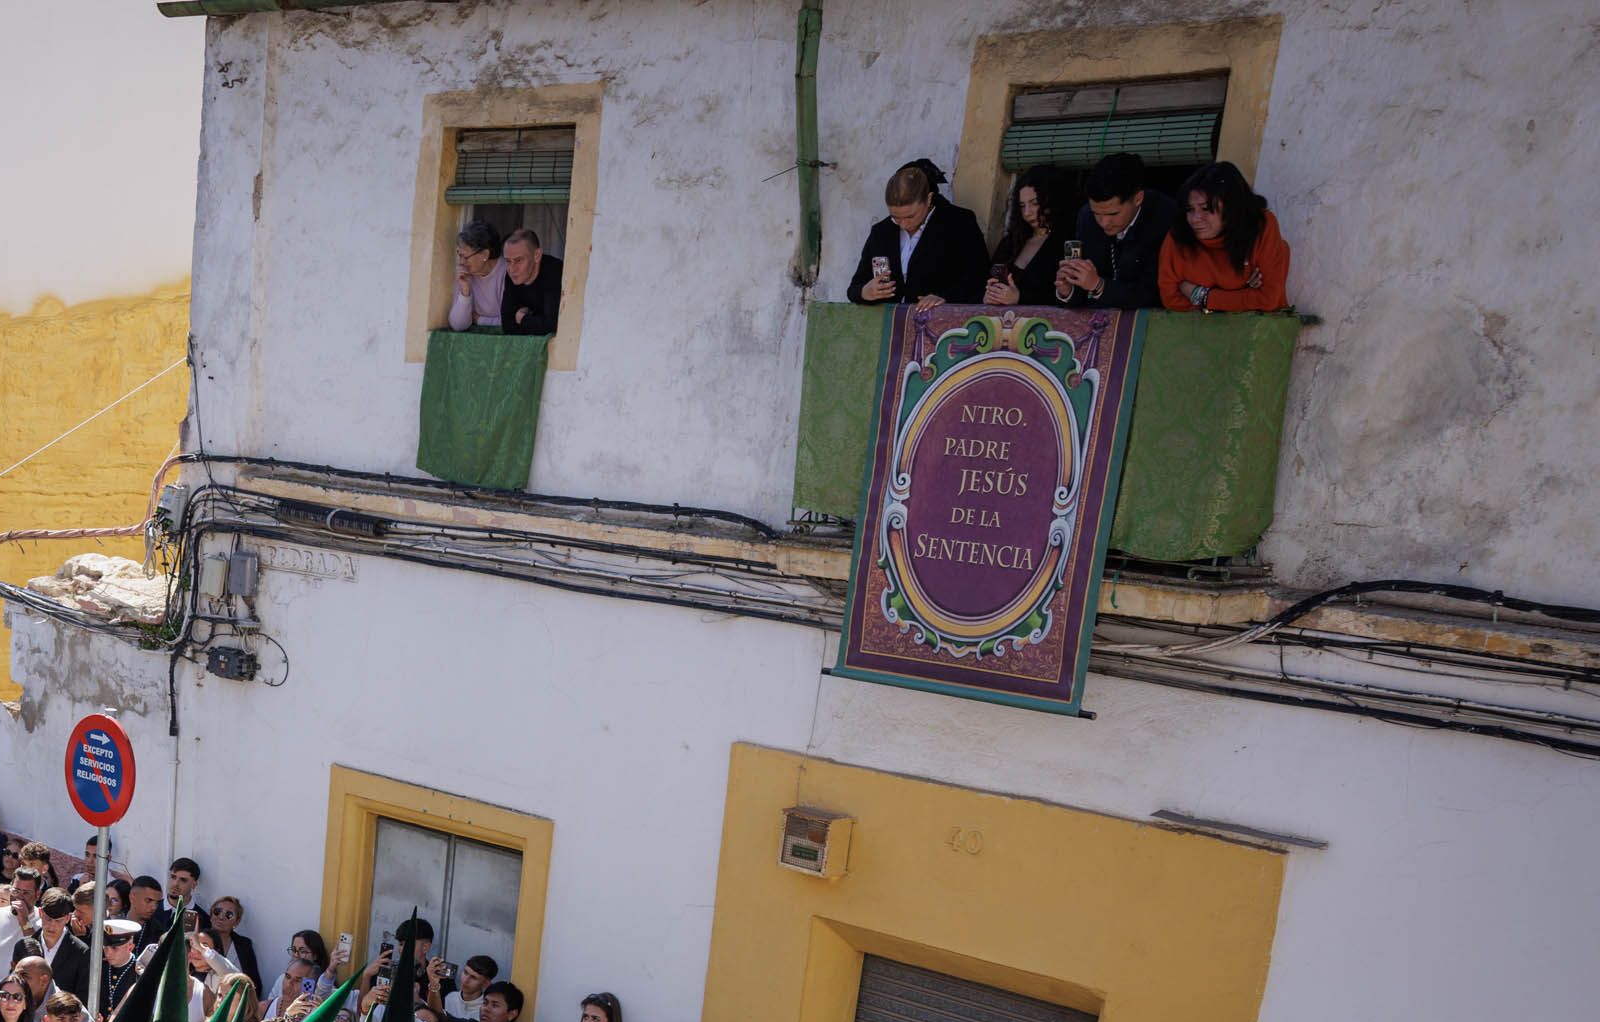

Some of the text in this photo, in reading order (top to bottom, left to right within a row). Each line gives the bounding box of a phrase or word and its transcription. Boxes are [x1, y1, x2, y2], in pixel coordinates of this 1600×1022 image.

[960, 404, 1028, 427] NTRO.
[943, 437, 1011, 461] PADRE
[957, 467, 1029, 497] JESÚS
[949, 507, 1001, 528] DE LA
[260, 544, 357, 578] PEDRADA
[913, 532, 1034, 571] SENTENCIA
[82, 743, 114, 760] EXCEPTO
[79, 756, 116, 774] SERVICIOS
[76, 769, 117, 788] RELIGIOSOS
